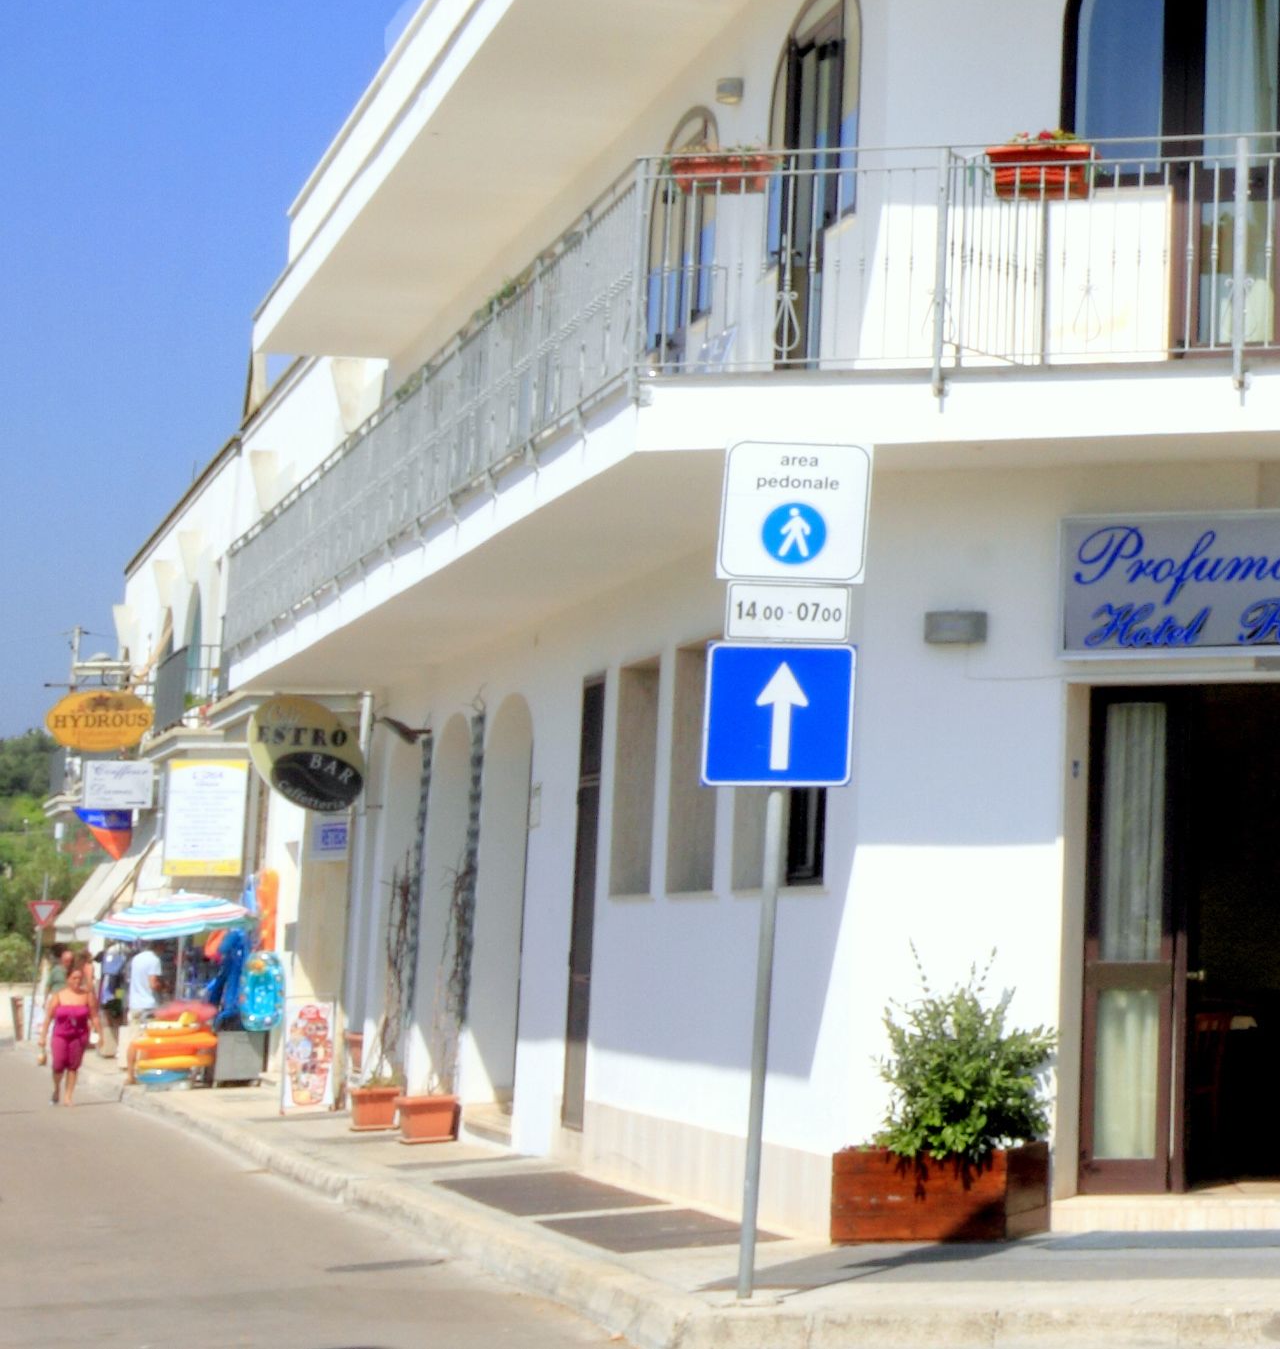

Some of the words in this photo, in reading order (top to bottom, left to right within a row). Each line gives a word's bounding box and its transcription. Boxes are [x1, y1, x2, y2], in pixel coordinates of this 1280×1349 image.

[780, 455, 820, 467] area
[756, 475, 841, 491] pedonale
[1084, 601, 1213, 648] Hotel
[54, 713, 149, 729] HYDROUS
[309, 754, 354, 784] BAR
